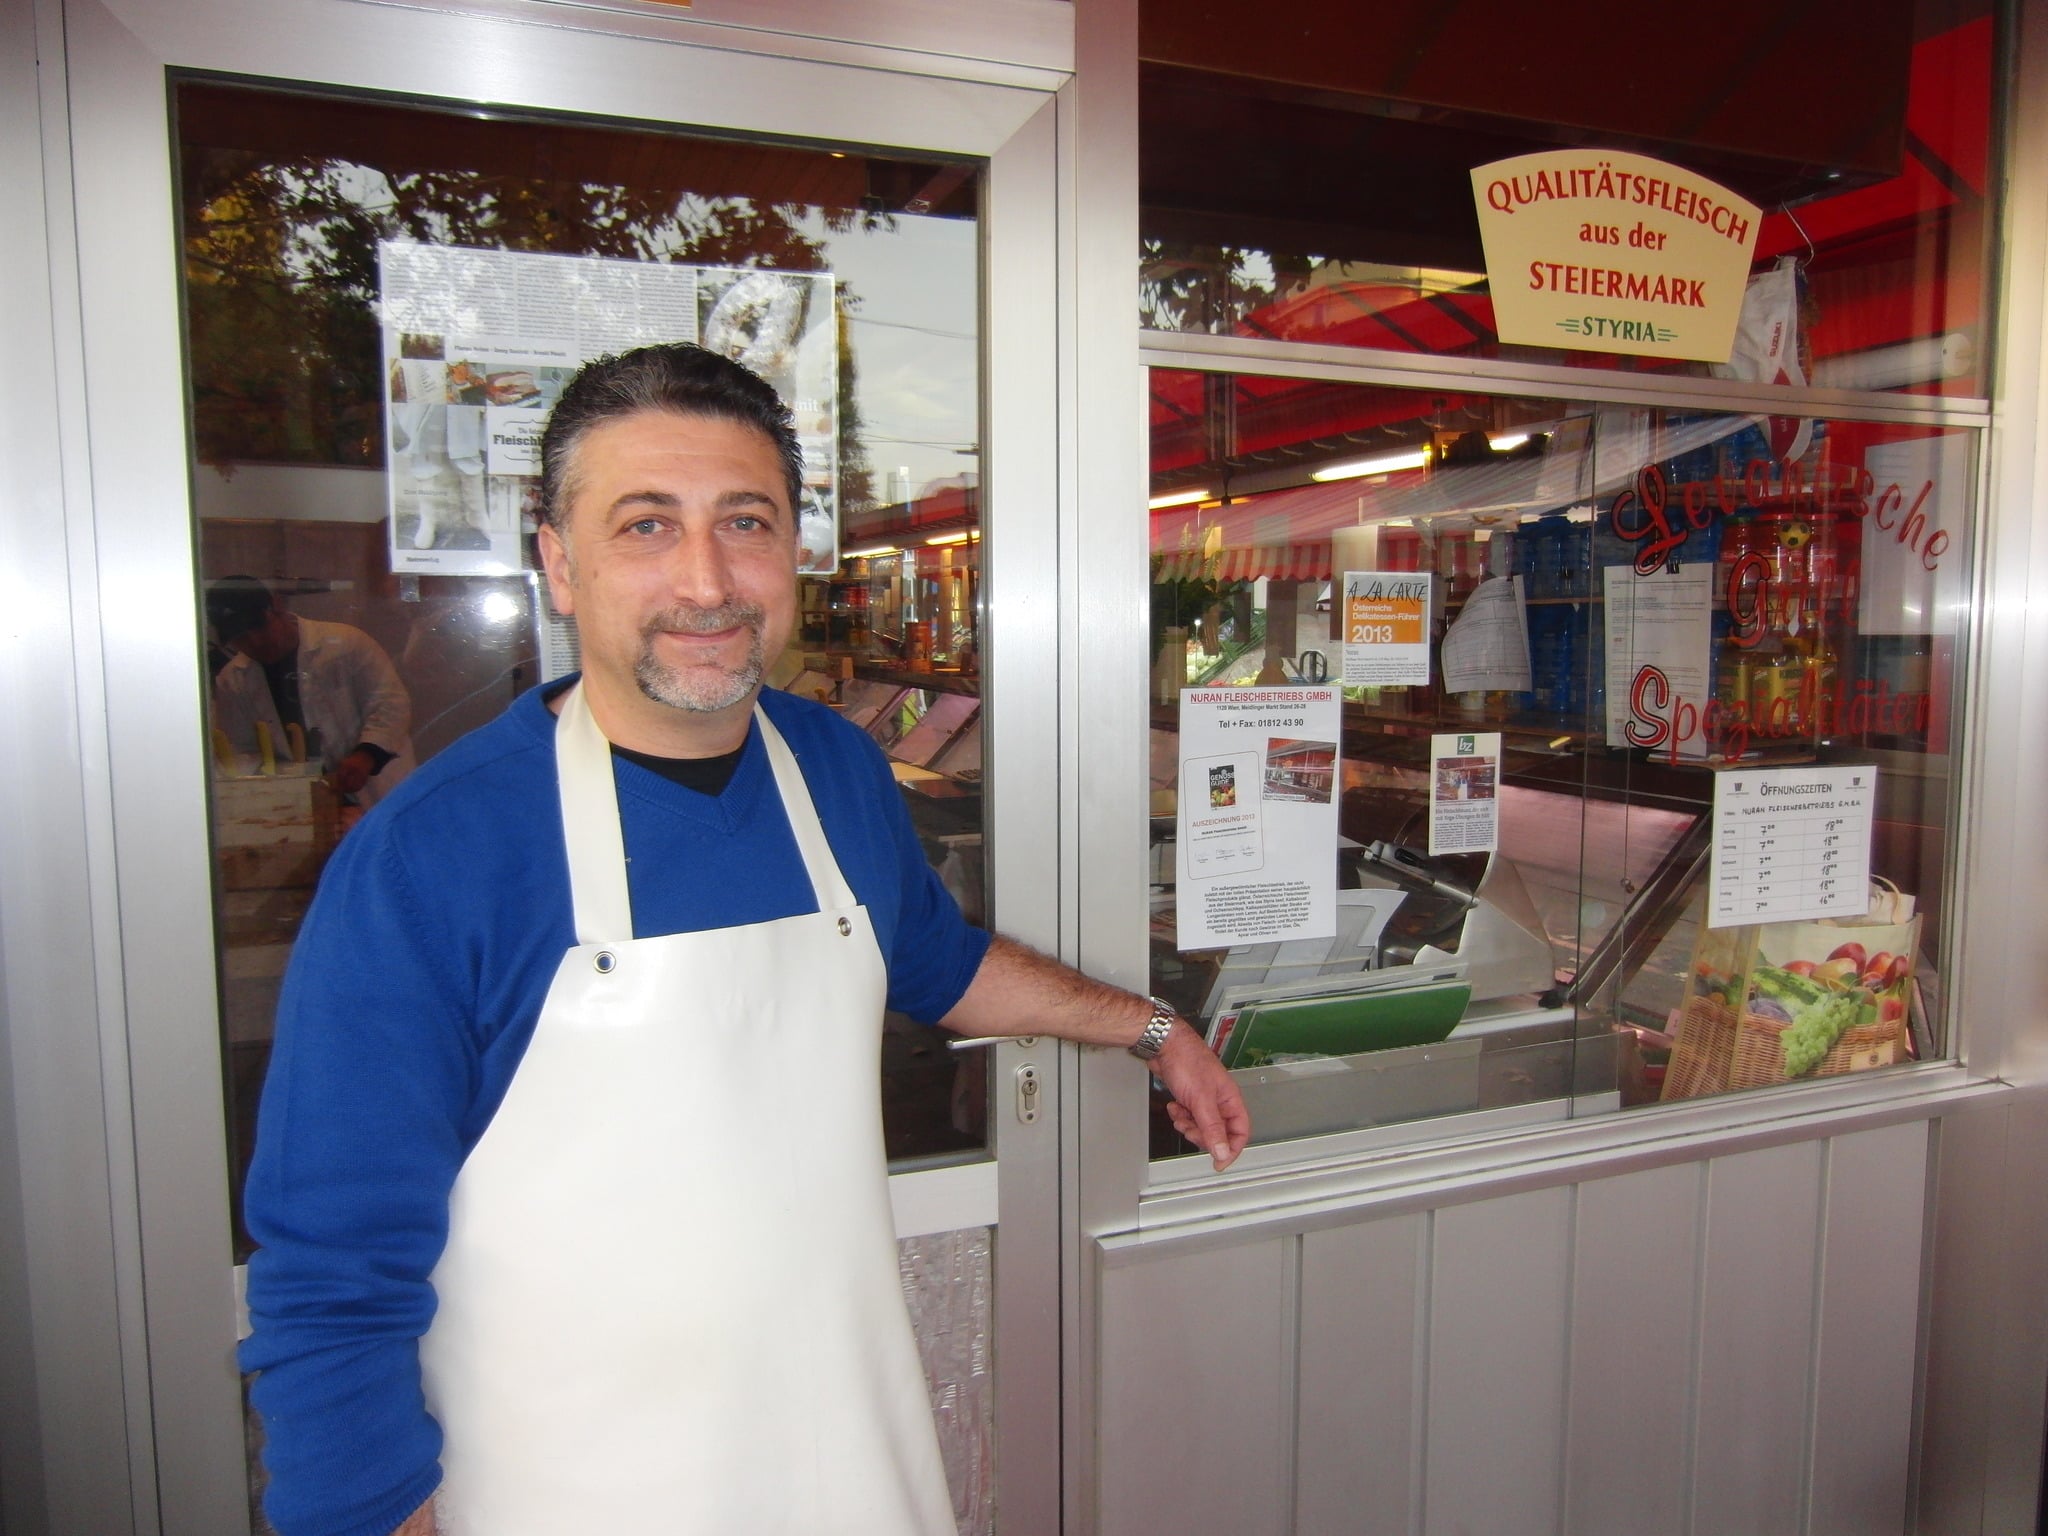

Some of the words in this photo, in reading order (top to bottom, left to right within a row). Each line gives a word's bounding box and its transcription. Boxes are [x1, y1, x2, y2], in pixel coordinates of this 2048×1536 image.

[1487, 162, 1748, 244] QUALITÄTSFLEISCH
[1579, 223, 1619, 245] aus
[1629, 222, 1667, 250] der
[1529, 261, 1705, 308] STEIERMARK
[1583, 316, 1656, 342] STYRIA
[1770, 321, 1782, 357] SUZUKI
[1361, 580, 1382, 602] LA
[1388, 582, 1428, 606] CARTE
[1352, 603, 1392, 612] Österreichs
[1352, 612, 1420, 620] Delikatessen-Führer
[1352, 625, 1392, 643] 2013
[1190, 692, 1222, 703] NURAN
[1224, 692, 1304, 702] FLEISCHBETRIEBS
[1306, 691, 1332, 700] GMBH
[1625, 664, 1931, 767] Spezialitäten
[1459, 738, 1472, 752] bz
[1760, 782, 1832, 796] ÖFFNUNGSZEITEN
[1742, 805, 1766, 816] NURAN
[1192, 816, 1240, 827] AUSZEICHNUNG
